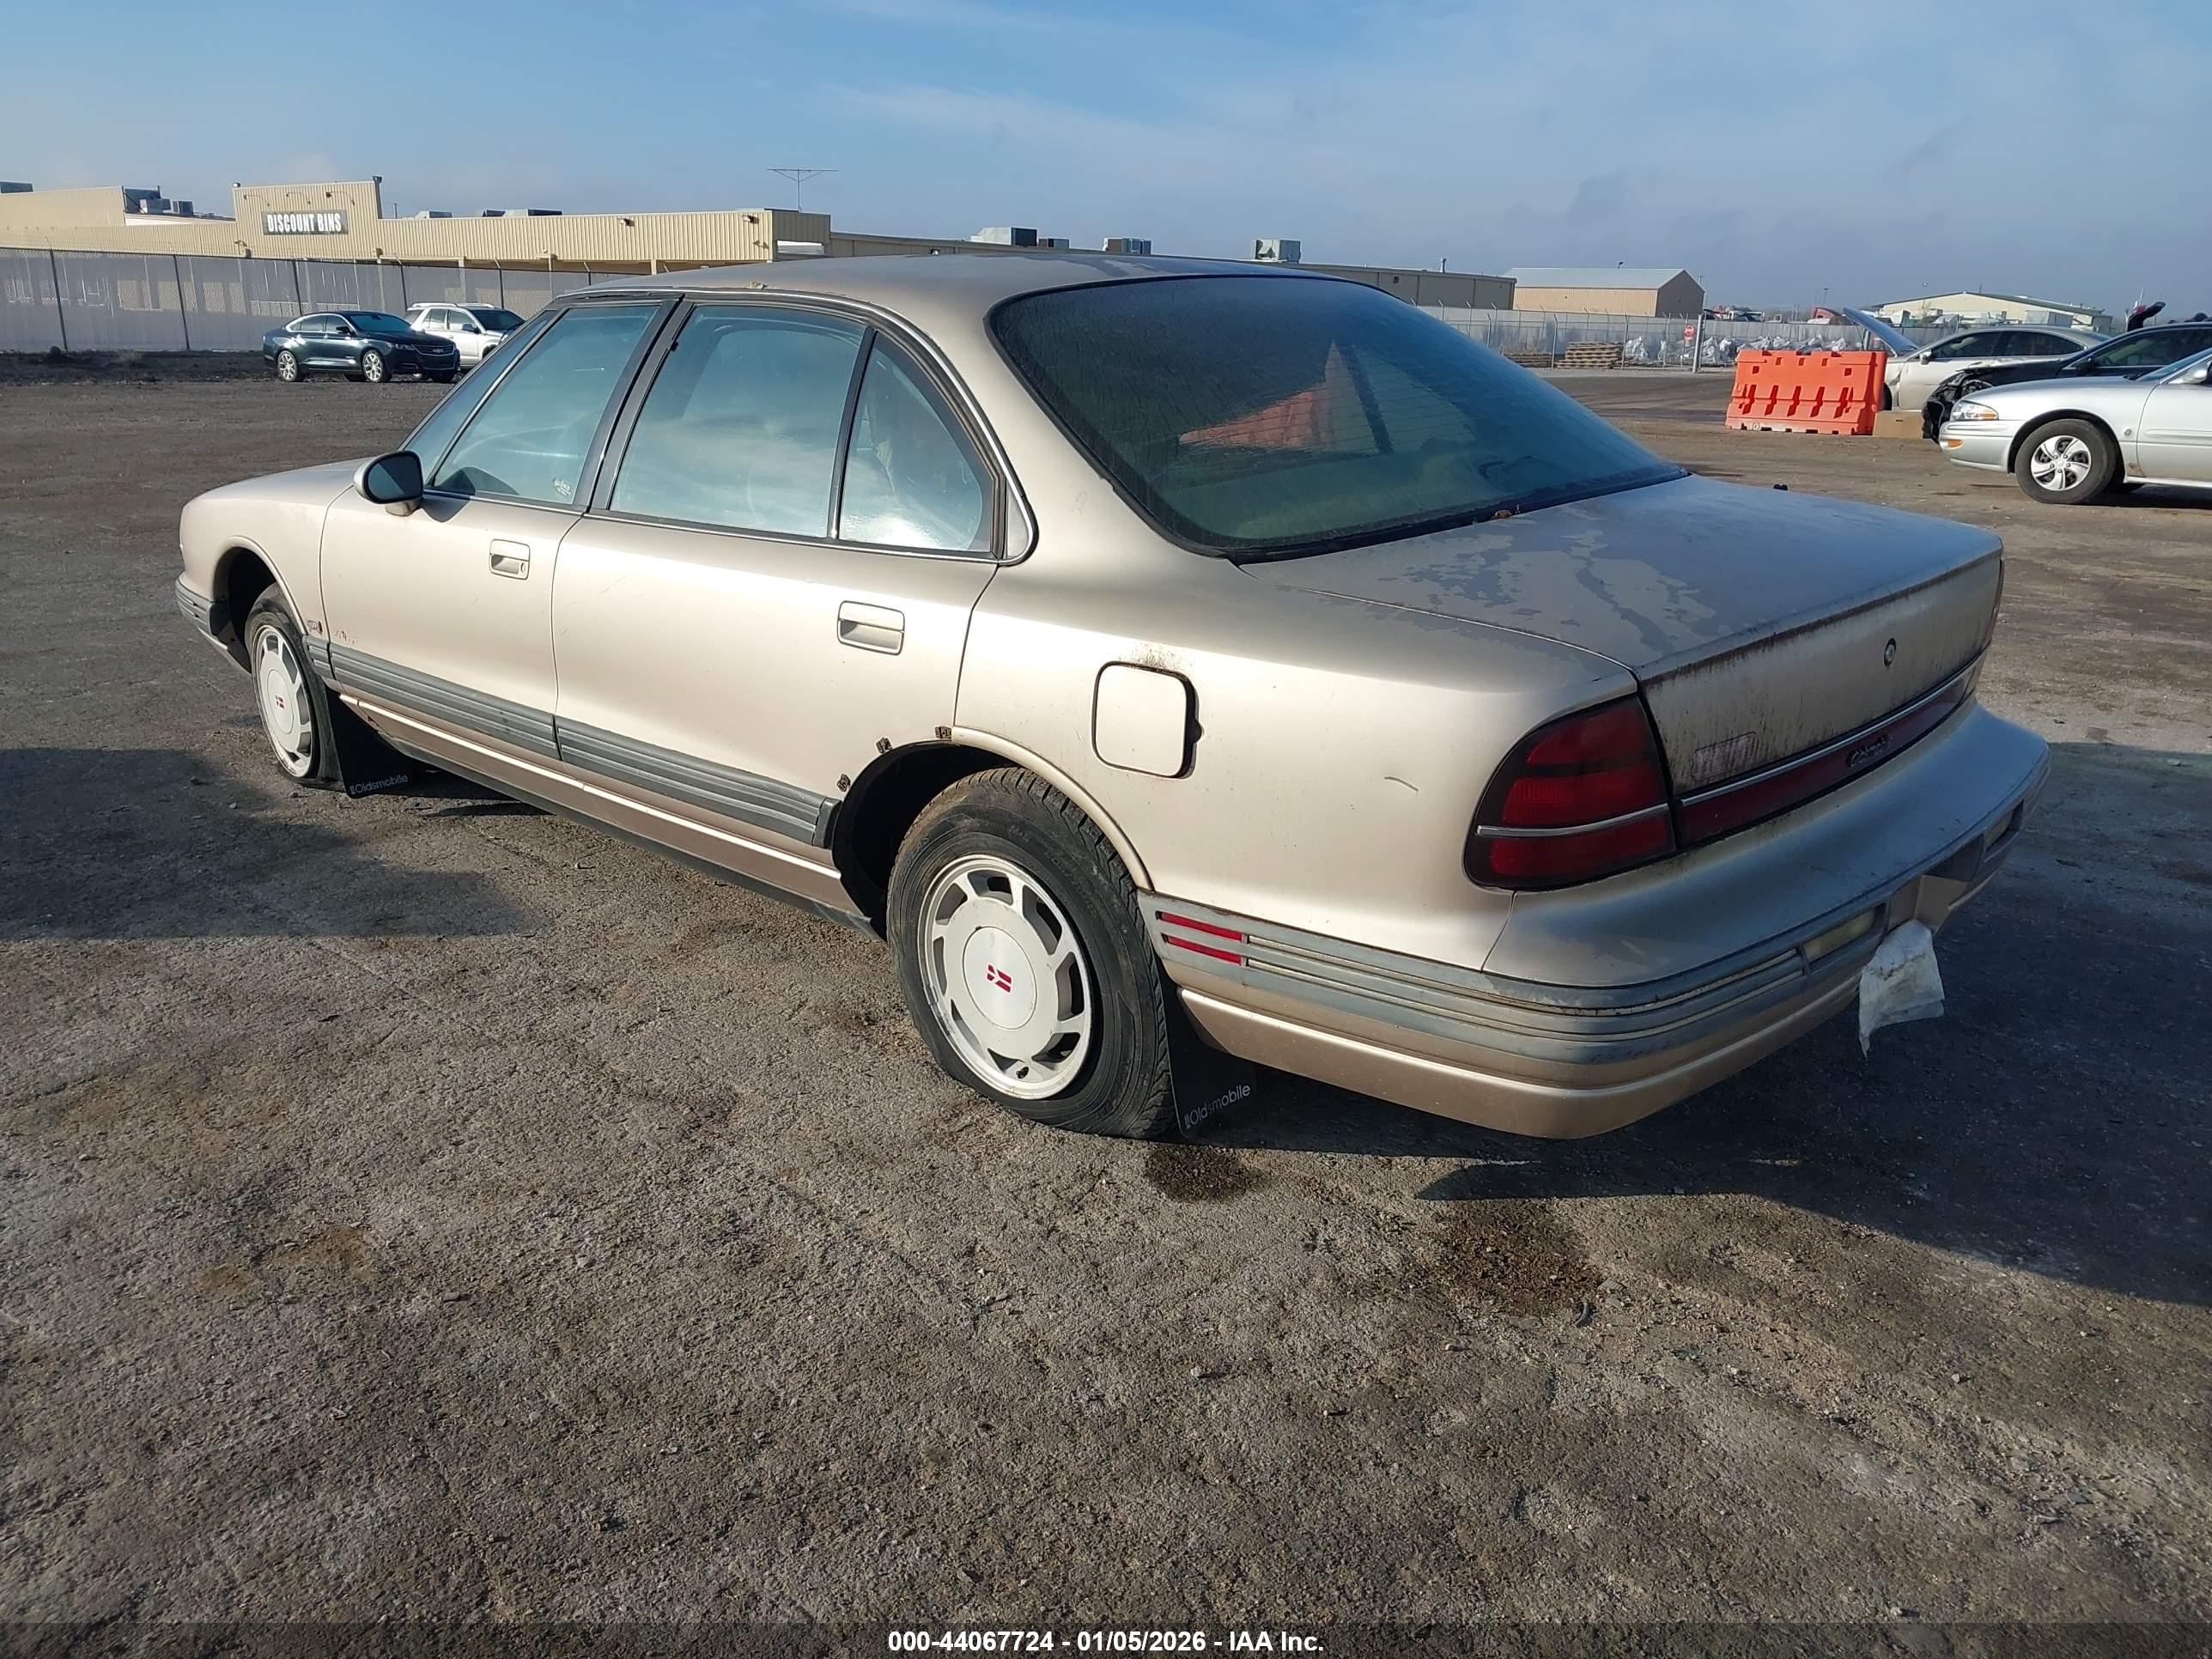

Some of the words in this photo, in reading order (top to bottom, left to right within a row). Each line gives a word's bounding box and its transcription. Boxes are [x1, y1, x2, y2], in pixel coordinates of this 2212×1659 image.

[267, 213, 315, 233] DISCOUNT
[317, 212, 342, 232] BINS
[355, 775, 409, 793] Oldsmobile
[1189, 1085, 1251, 1125] Oldsmobile
